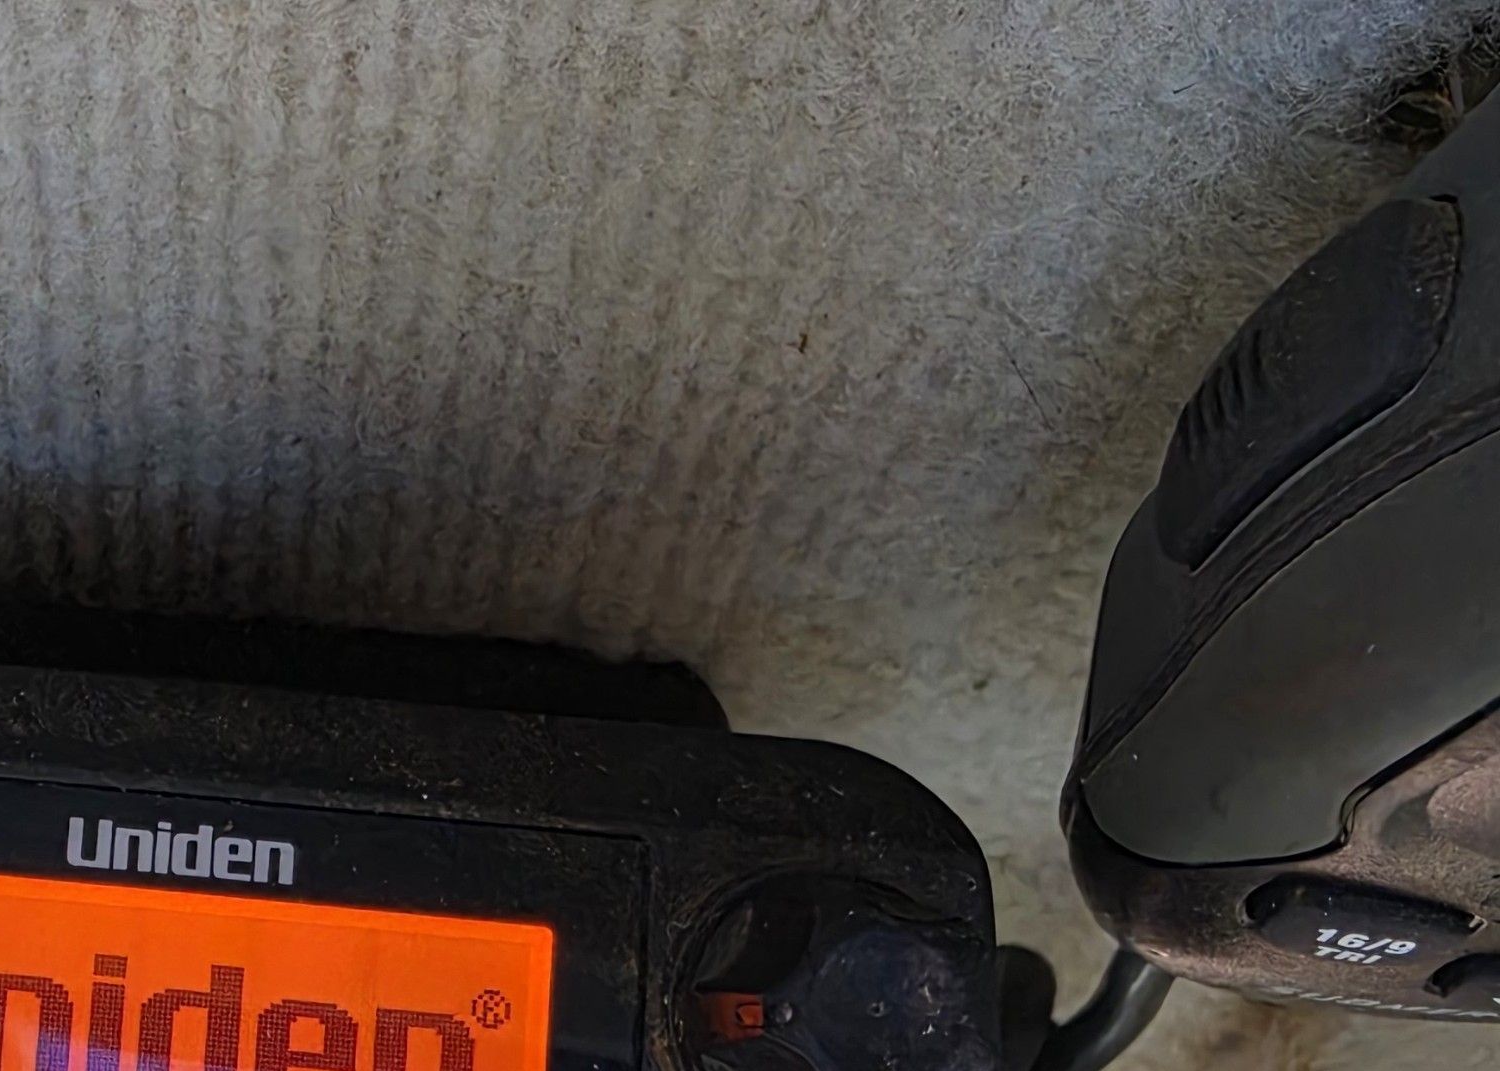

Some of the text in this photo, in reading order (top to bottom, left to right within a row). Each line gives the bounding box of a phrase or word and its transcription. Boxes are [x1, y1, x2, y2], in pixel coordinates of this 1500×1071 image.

[67, 816, 296, 886] Uniden
[1314, 945, 1382, 964] TRI
[1315, 928, 1416, 955] 16/9
